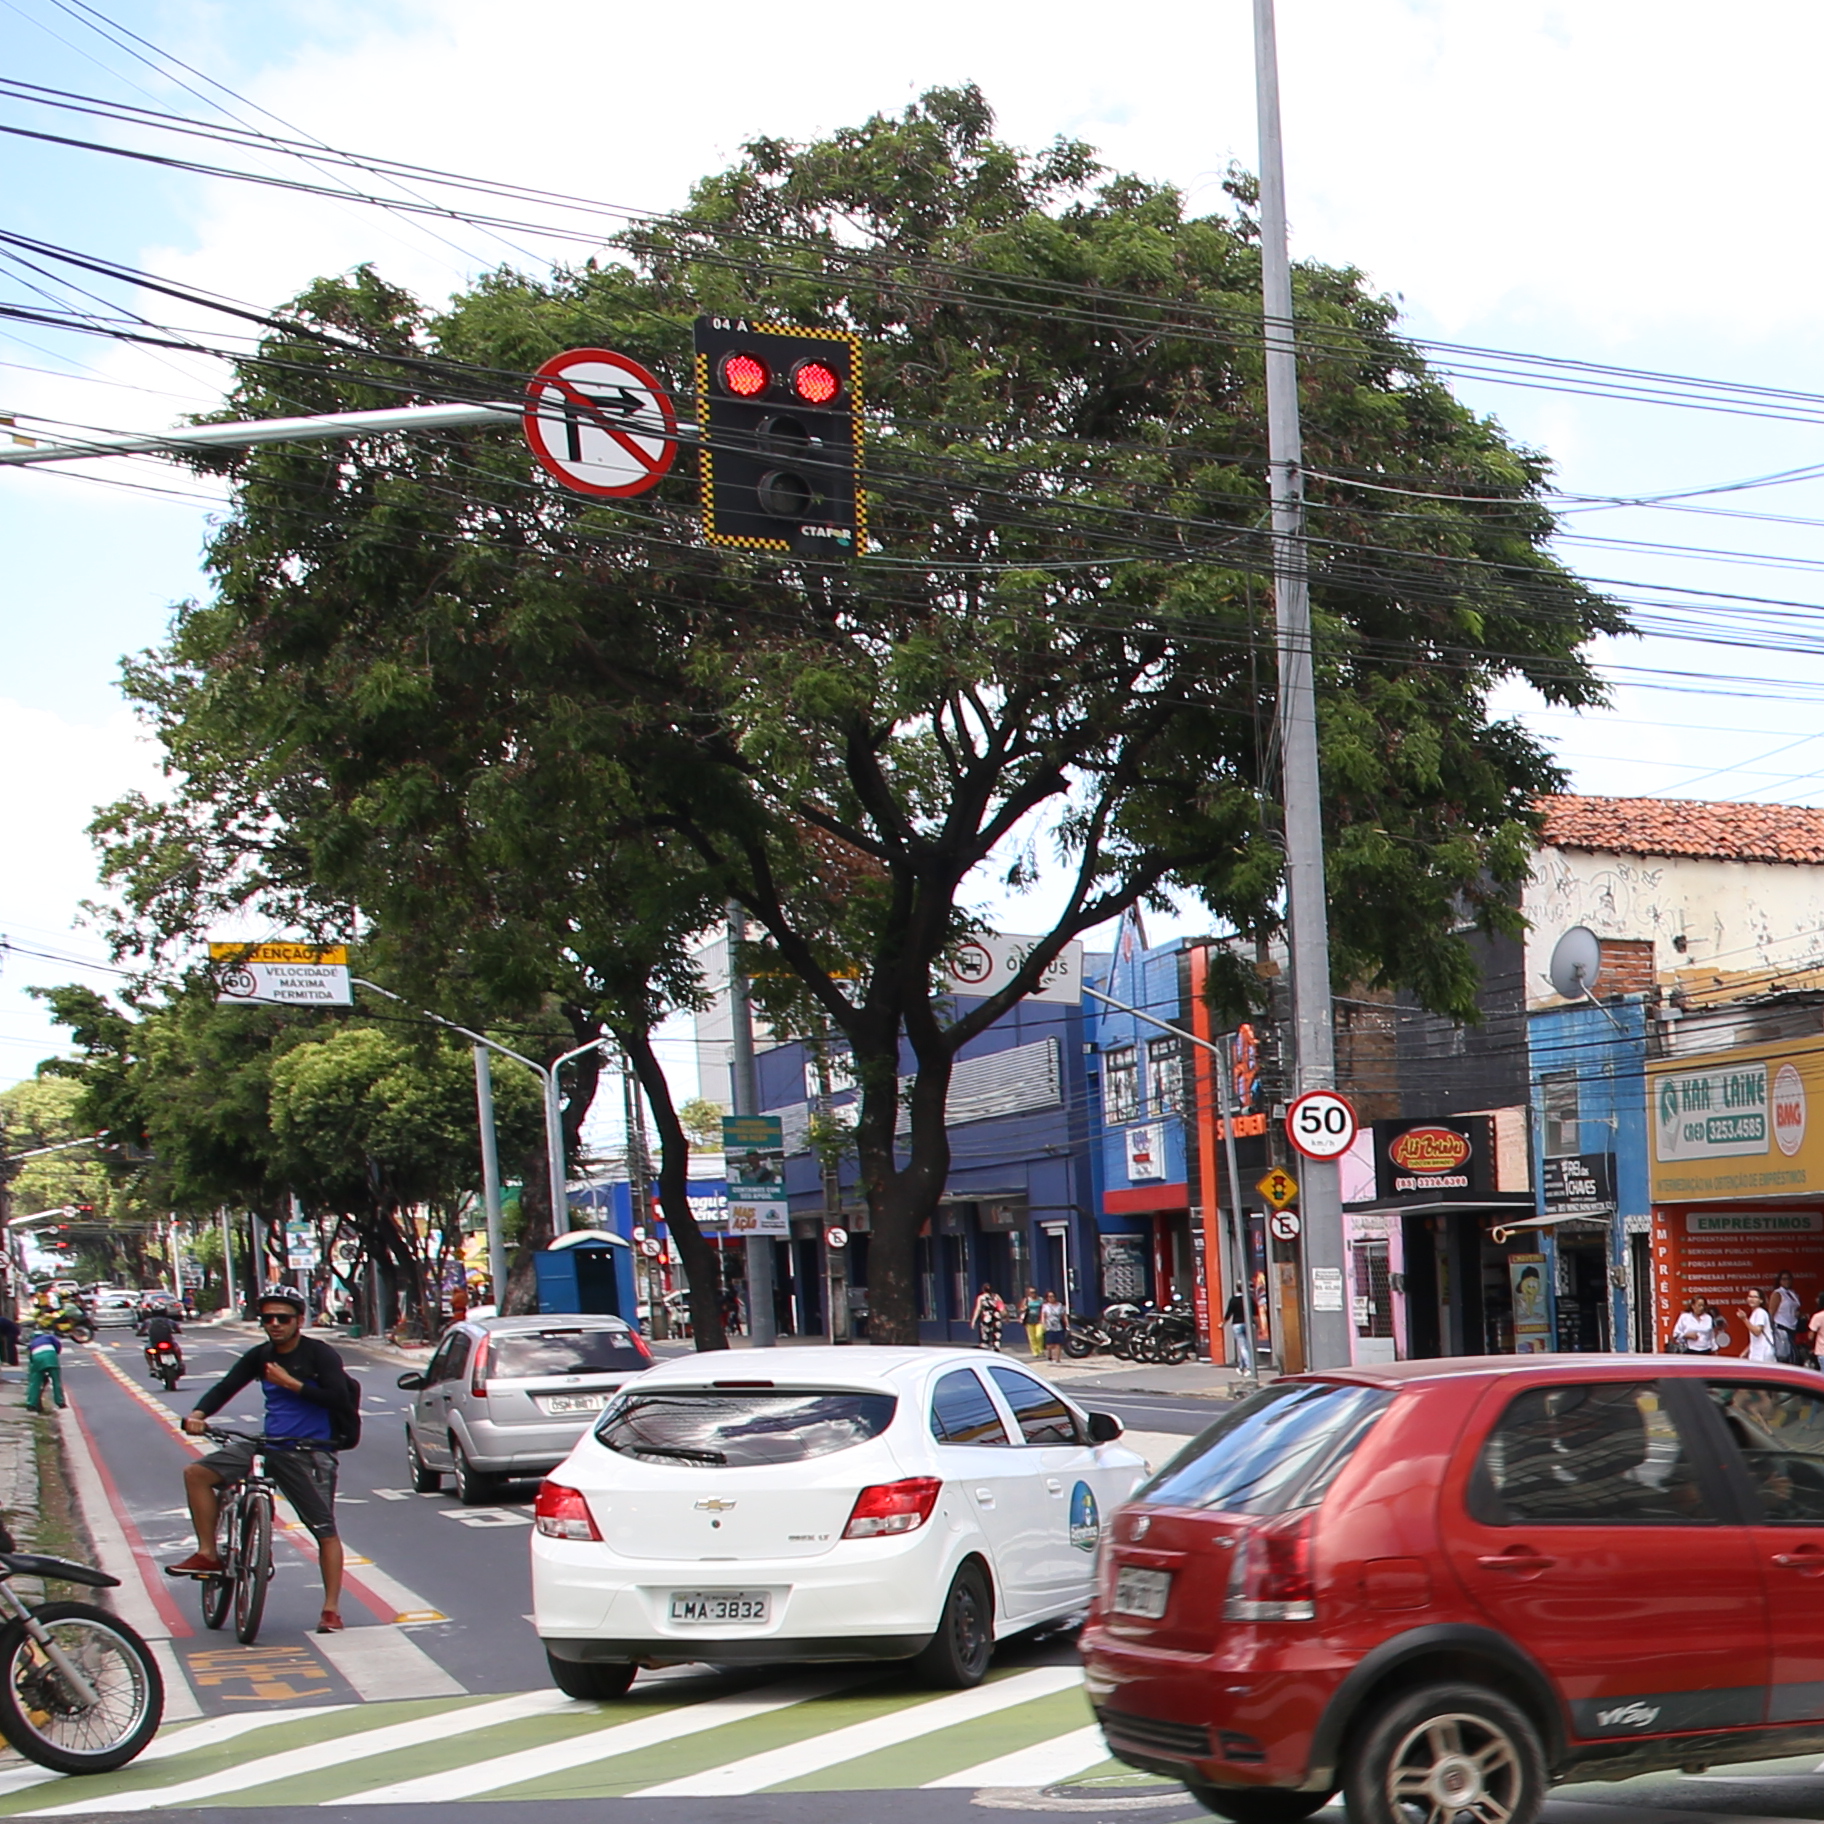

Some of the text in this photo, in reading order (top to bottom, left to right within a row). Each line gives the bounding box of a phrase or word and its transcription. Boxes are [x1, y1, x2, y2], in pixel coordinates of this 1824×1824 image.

[266, 968, 337, 977] VELOCIDADE
[280, 978, 325, 988] MÁXIMA
[274, 990, 334, 999] PERMITIDA
[1300, 1106, 1346, 1134] 50
[1777, 1102, 1801, 1127] BMG
[1684, 1122, 1705, 1142] CRED
[1709, 1118, 1761, 1140] 3253.4585
[1760, 1169, 1806, 1186] EMPRÉSTIMOS
[733, 1207, 756, 1217] MAIS
[1698, 1217, 1811, 1230] EMPRÉSTIMOS
[1688, 1261, 1715, 1269] FORÇAS
[672, 1602, 764, 1619] LMA-3832
